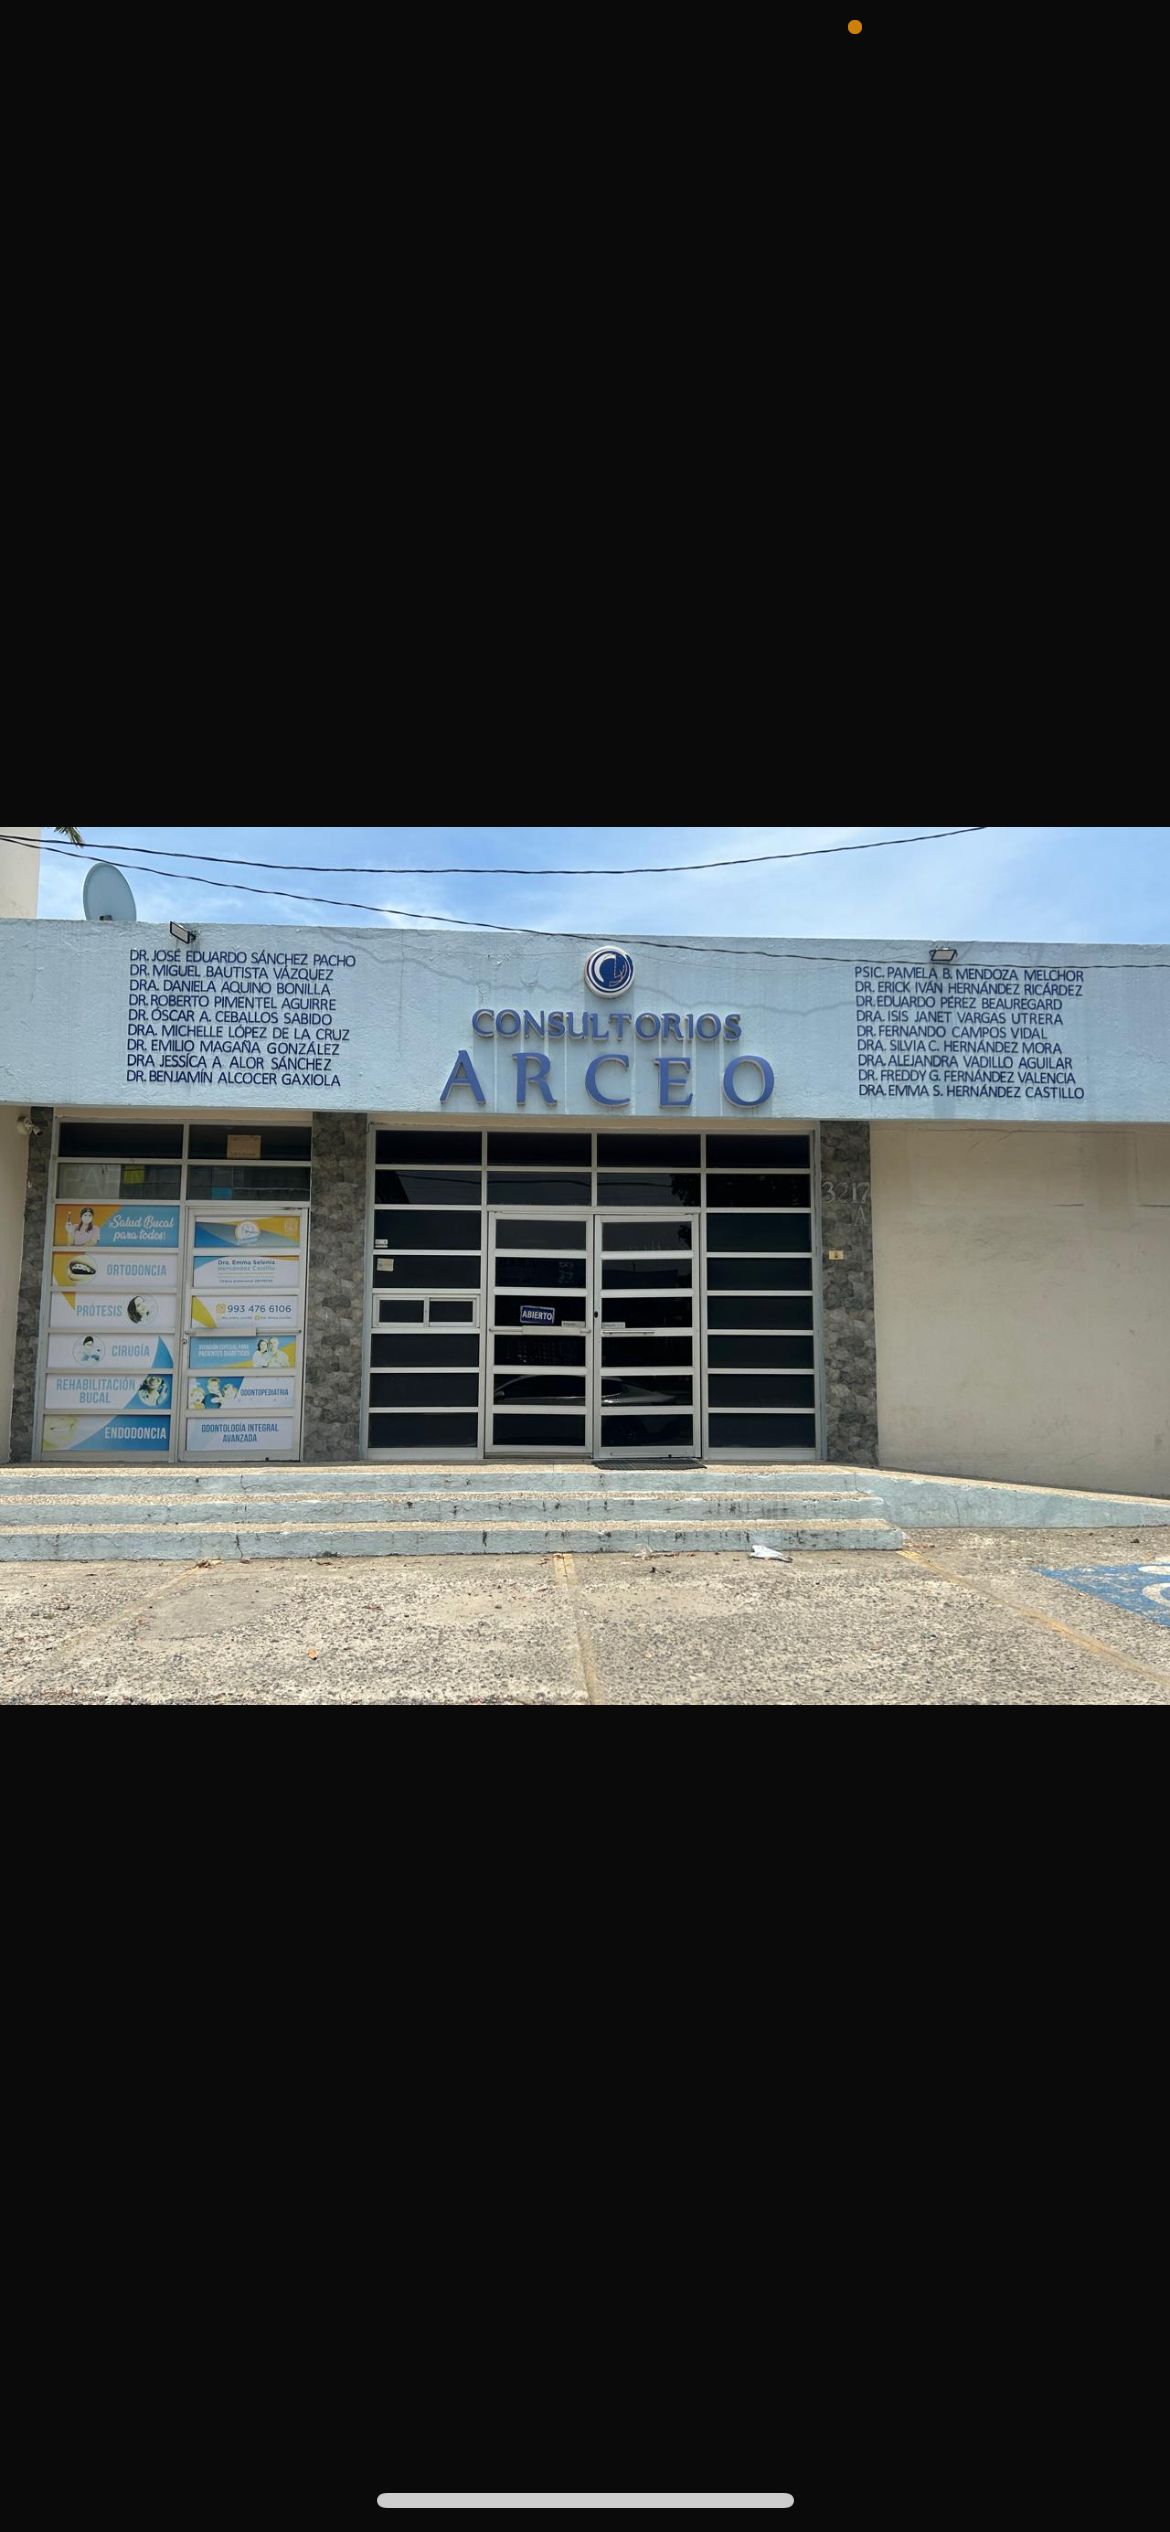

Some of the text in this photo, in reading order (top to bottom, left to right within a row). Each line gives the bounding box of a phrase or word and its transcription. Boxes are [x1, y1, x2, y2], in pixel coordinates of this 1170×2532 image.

[130, 950, 149, 961] DR.
[186, 951, 247, 963] EDUARDO
[251, 950, 308, 965] SÁNCHEZ
[313, 954, 356, 967] PACHO
[130, 965, 333, 981] DR. MIGUEL BAUTISTA VÁZQUEZ
[855, 966, 1084, 982] PSIC. PAMELA B. MENDOZA MELCHOR
[130, 980, 330, 995] DRA. DANIELA AQUINO BONILLA
[855, 981, 1082, 996] DR. ERICK IVÁN HERNÁNDEZ RICÁRDEZ
[129, 995, 336, 1010] DR. ROBERTO PIMENTEL AGUIRRE
[856, 996, 875, 1007] DR.
[877, 996, 935, 1008] EDUARDO
[982, 998, 1062, 1010] BEAUREGARD
[129, 1007, 332, 1025] DR. ÓSCAR A. CEBALLOS SABIDO
[856, 1010, 1063, 1025] DRA. ISIS JANET VARGAS UTRERA
[128, 1024, 349, 1041] DRA. MICHELLE LÓPEZ DE LA CRUZ
[472, 1009, 743, 1041] CONSULTORIOS
[857, 1025, 1047, 1039] DR. FERNANDO CAMPOS VIDAL
[127, 1039, 339, 1055] DR. EMILIO MAGAÑA GONZÁLEZ
[858, 1039, 1062, 1054] DRA. SILVIA C. HERNÁNDEZ MORA
[229, 1057, 264, 1069] ALOR
[271, 1056, 331, 1071] SÁNCHEZ
[858, 1054, 1072, 1069] DRA. ALEJANDRA VADILLO AGUILAR
[127, 1070, 340, 1086] DR. BENJAMÍN ALCOCER GAXIOLA
[440, 1050, 775, 1108] ARCEO
[859, 1070, 1075, 1084] DR. FREDDY G. FERNÁNDEZ VALENCIA
[859, 1084, 1084, 1099] DRA. EMMA S. HERNÁNDEZ CASTILLO
[822, 1181, 870, 1203] 3217
[143, 1215, 174, 1229] Bucal
[113, 1231, 137, 1242] para
[106, 1264, 167, 1276] ORTODONCIA
[76, 1303, 122, 1317] PRÓTESIS
[227, 1304, 292, 1313] 993 476 6106
[522, 1310, 553, 1320] ABIERTO
[111, 1343, 150, 1357] CIRUGÍA
[56, 1377, 136, 1391] REHABILITACIÓN
[79, 1392, 110, 1404] BUCAL
[104, 1427, 167, 1439] ENDODONCIA
[248, 1423, 279, 1433] INTEGRAL
[222, 1434, 258, 1443] AVANZADA
